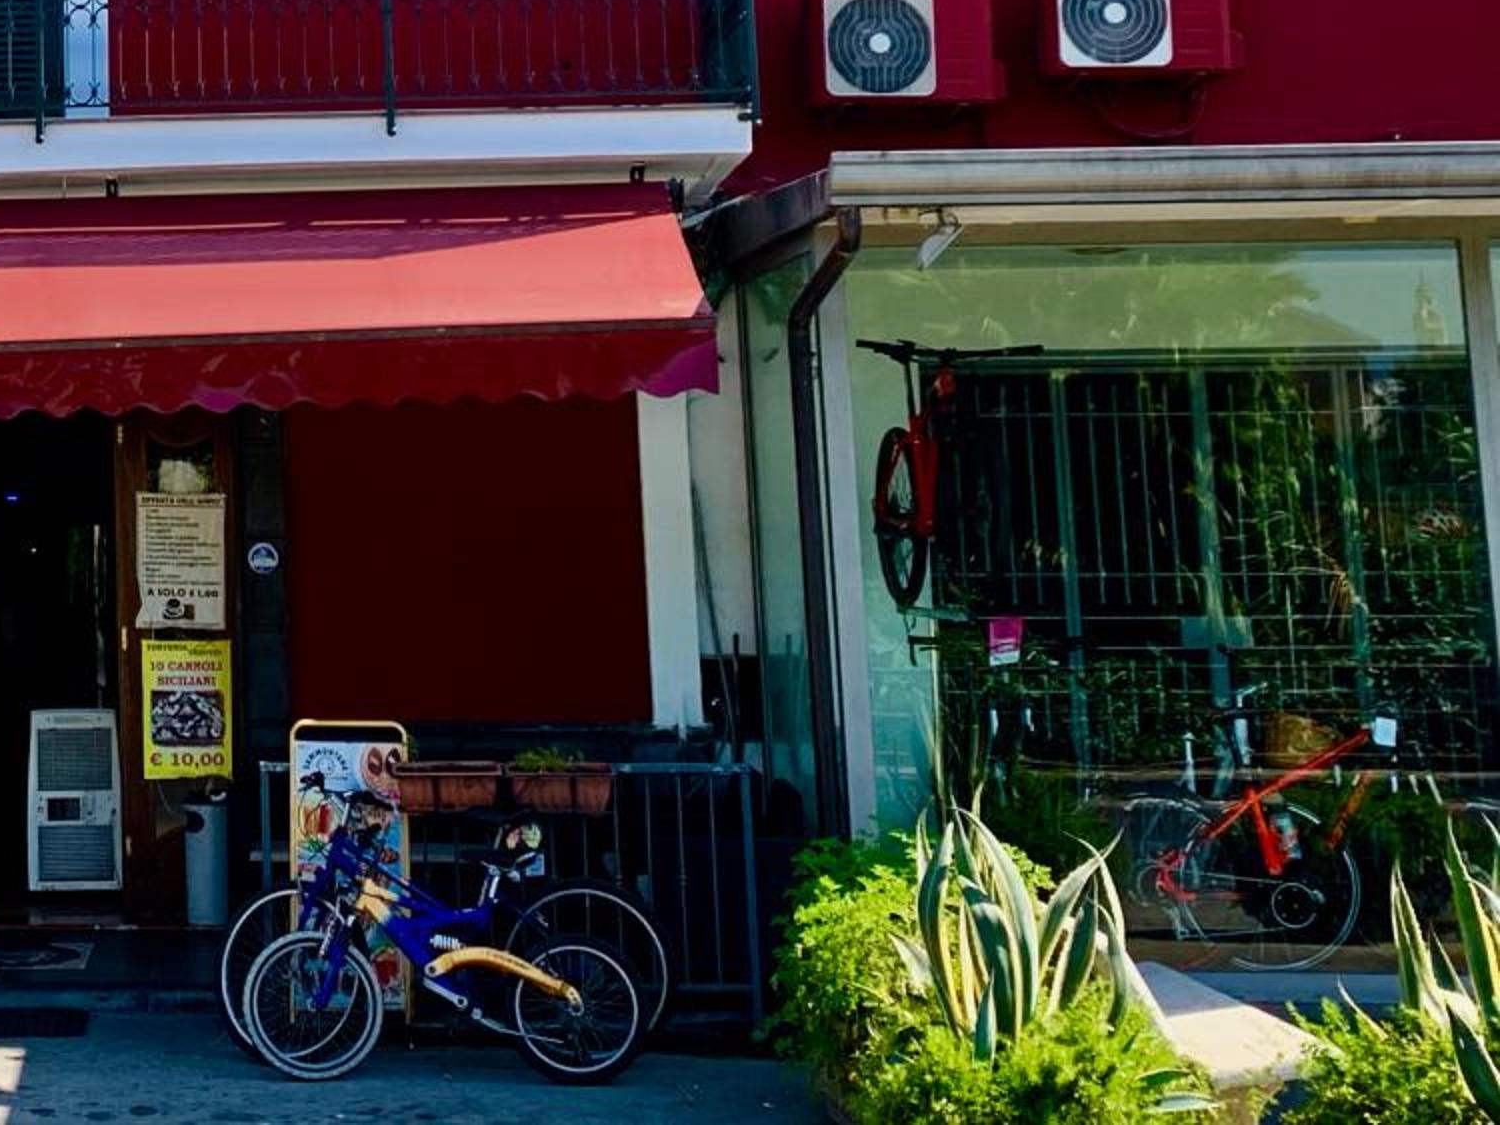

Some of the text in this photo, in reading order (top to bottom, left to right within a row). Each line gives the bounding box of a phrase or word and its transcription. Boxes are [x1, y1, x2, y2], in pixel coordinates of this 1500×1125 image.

[151, 660, 223, 671] 10 CANNOLI
[158, 676, 217, 686] SICILIANI
